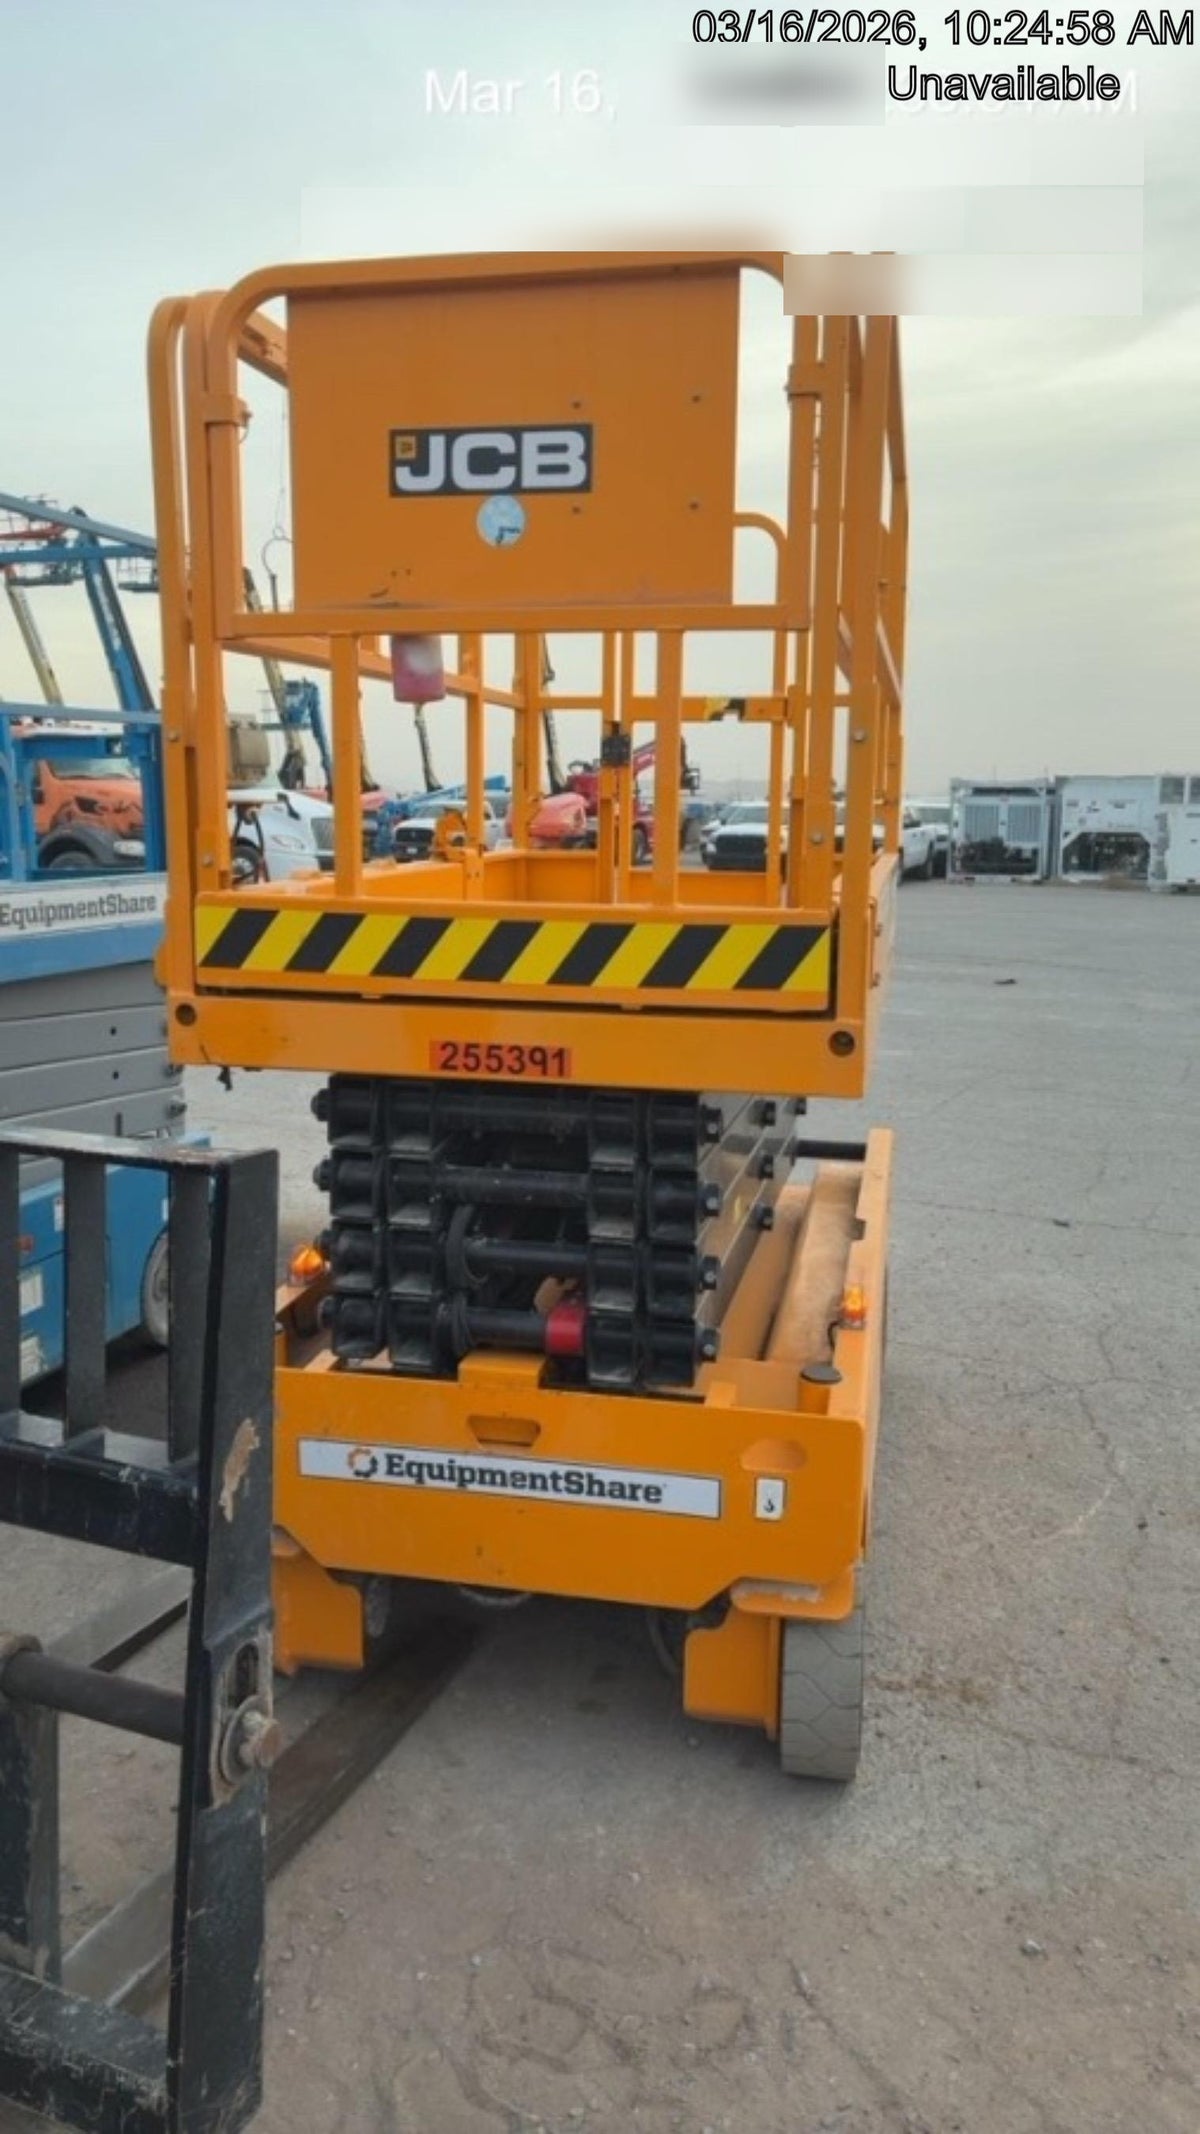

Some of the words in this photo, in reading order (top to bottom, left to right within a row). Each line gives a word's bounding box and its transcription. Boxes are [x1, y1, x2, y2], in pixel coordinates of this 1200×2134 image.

[396, 430, 587, 492] JCB
[0, 893, 157, 930] EquipmentShare
[439, 1041, 567, 1077] 255391
[385, 1452, 663, 1504] EquipmentShare
